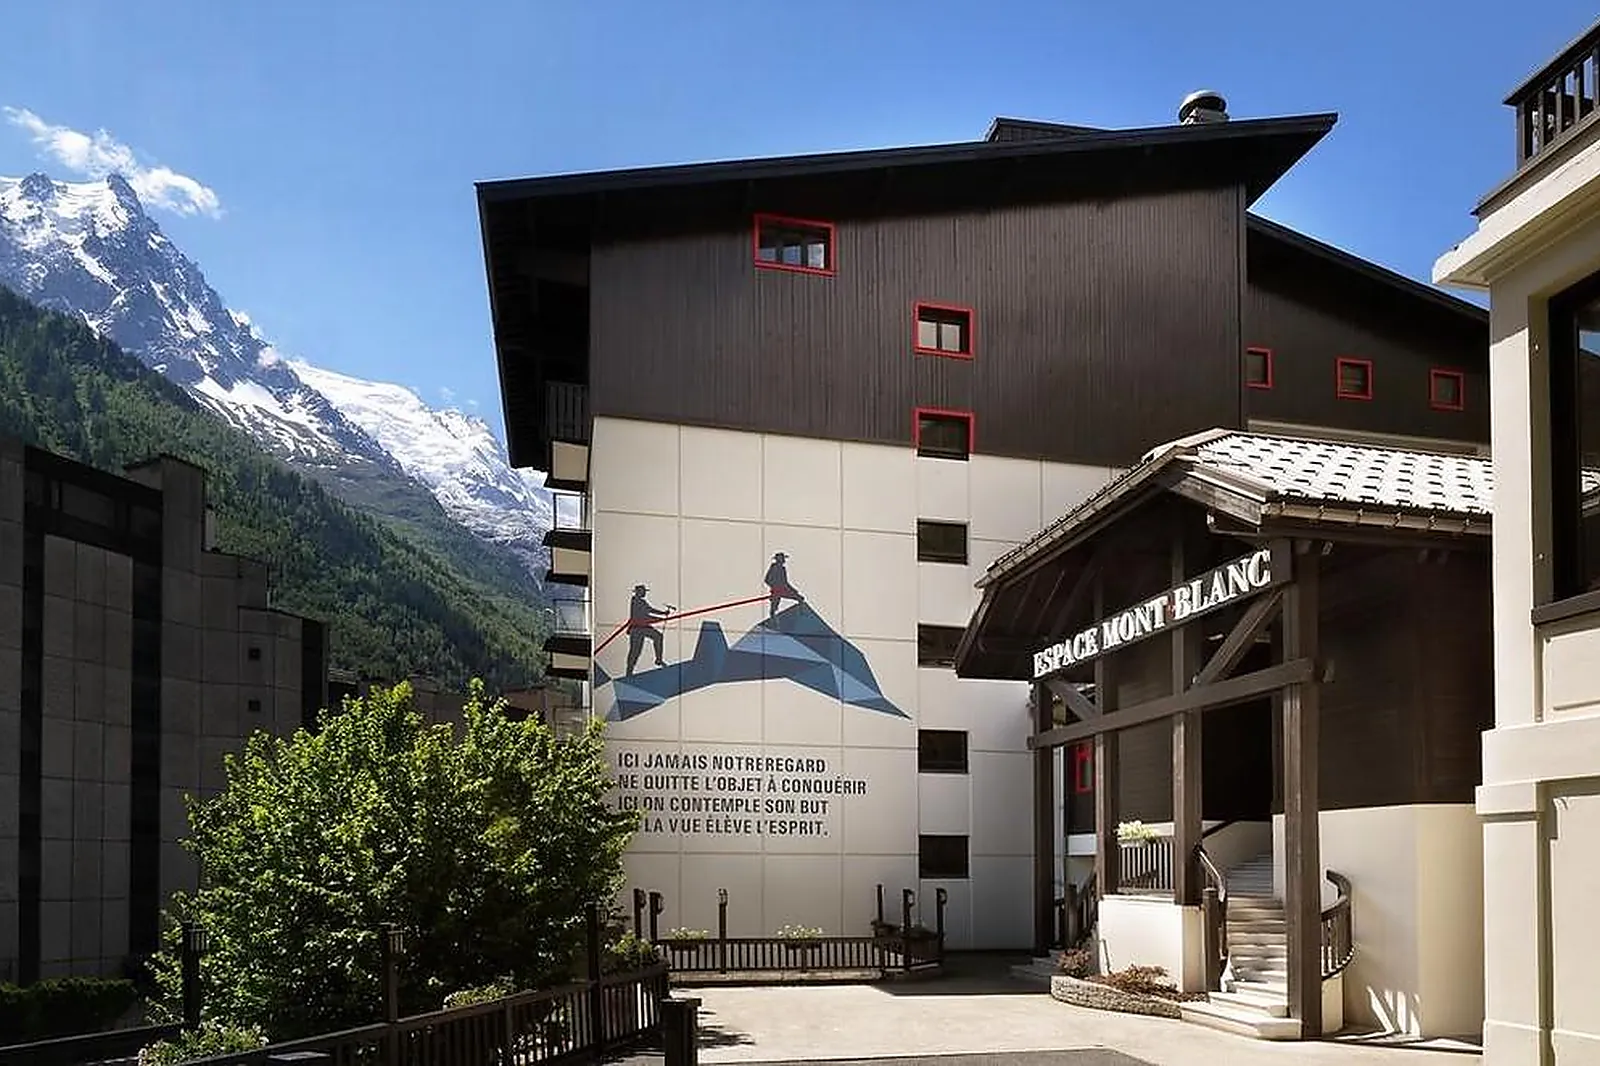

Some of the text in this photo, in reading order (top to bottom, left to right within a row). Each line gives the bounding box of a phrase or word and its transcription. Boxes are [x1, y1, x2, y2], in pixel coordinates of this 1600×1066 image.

[1033, 550, 1271, 678] ESPACE MONT BLANC
[618, 753, 639, 768] ICI
[643, 754, 708, 770] JAMAIS
[619, 775, 866, 795] NE QUITTE L'OBJET À CONQUÉRIR
[618, 796, 828, 815] ICI ON CONTEMPLE SON BUT
[644, 818, 664, 833] LA
[668, 819, 701, 834] VUE
[706, 814, 752, 834] ÉLÈVE
